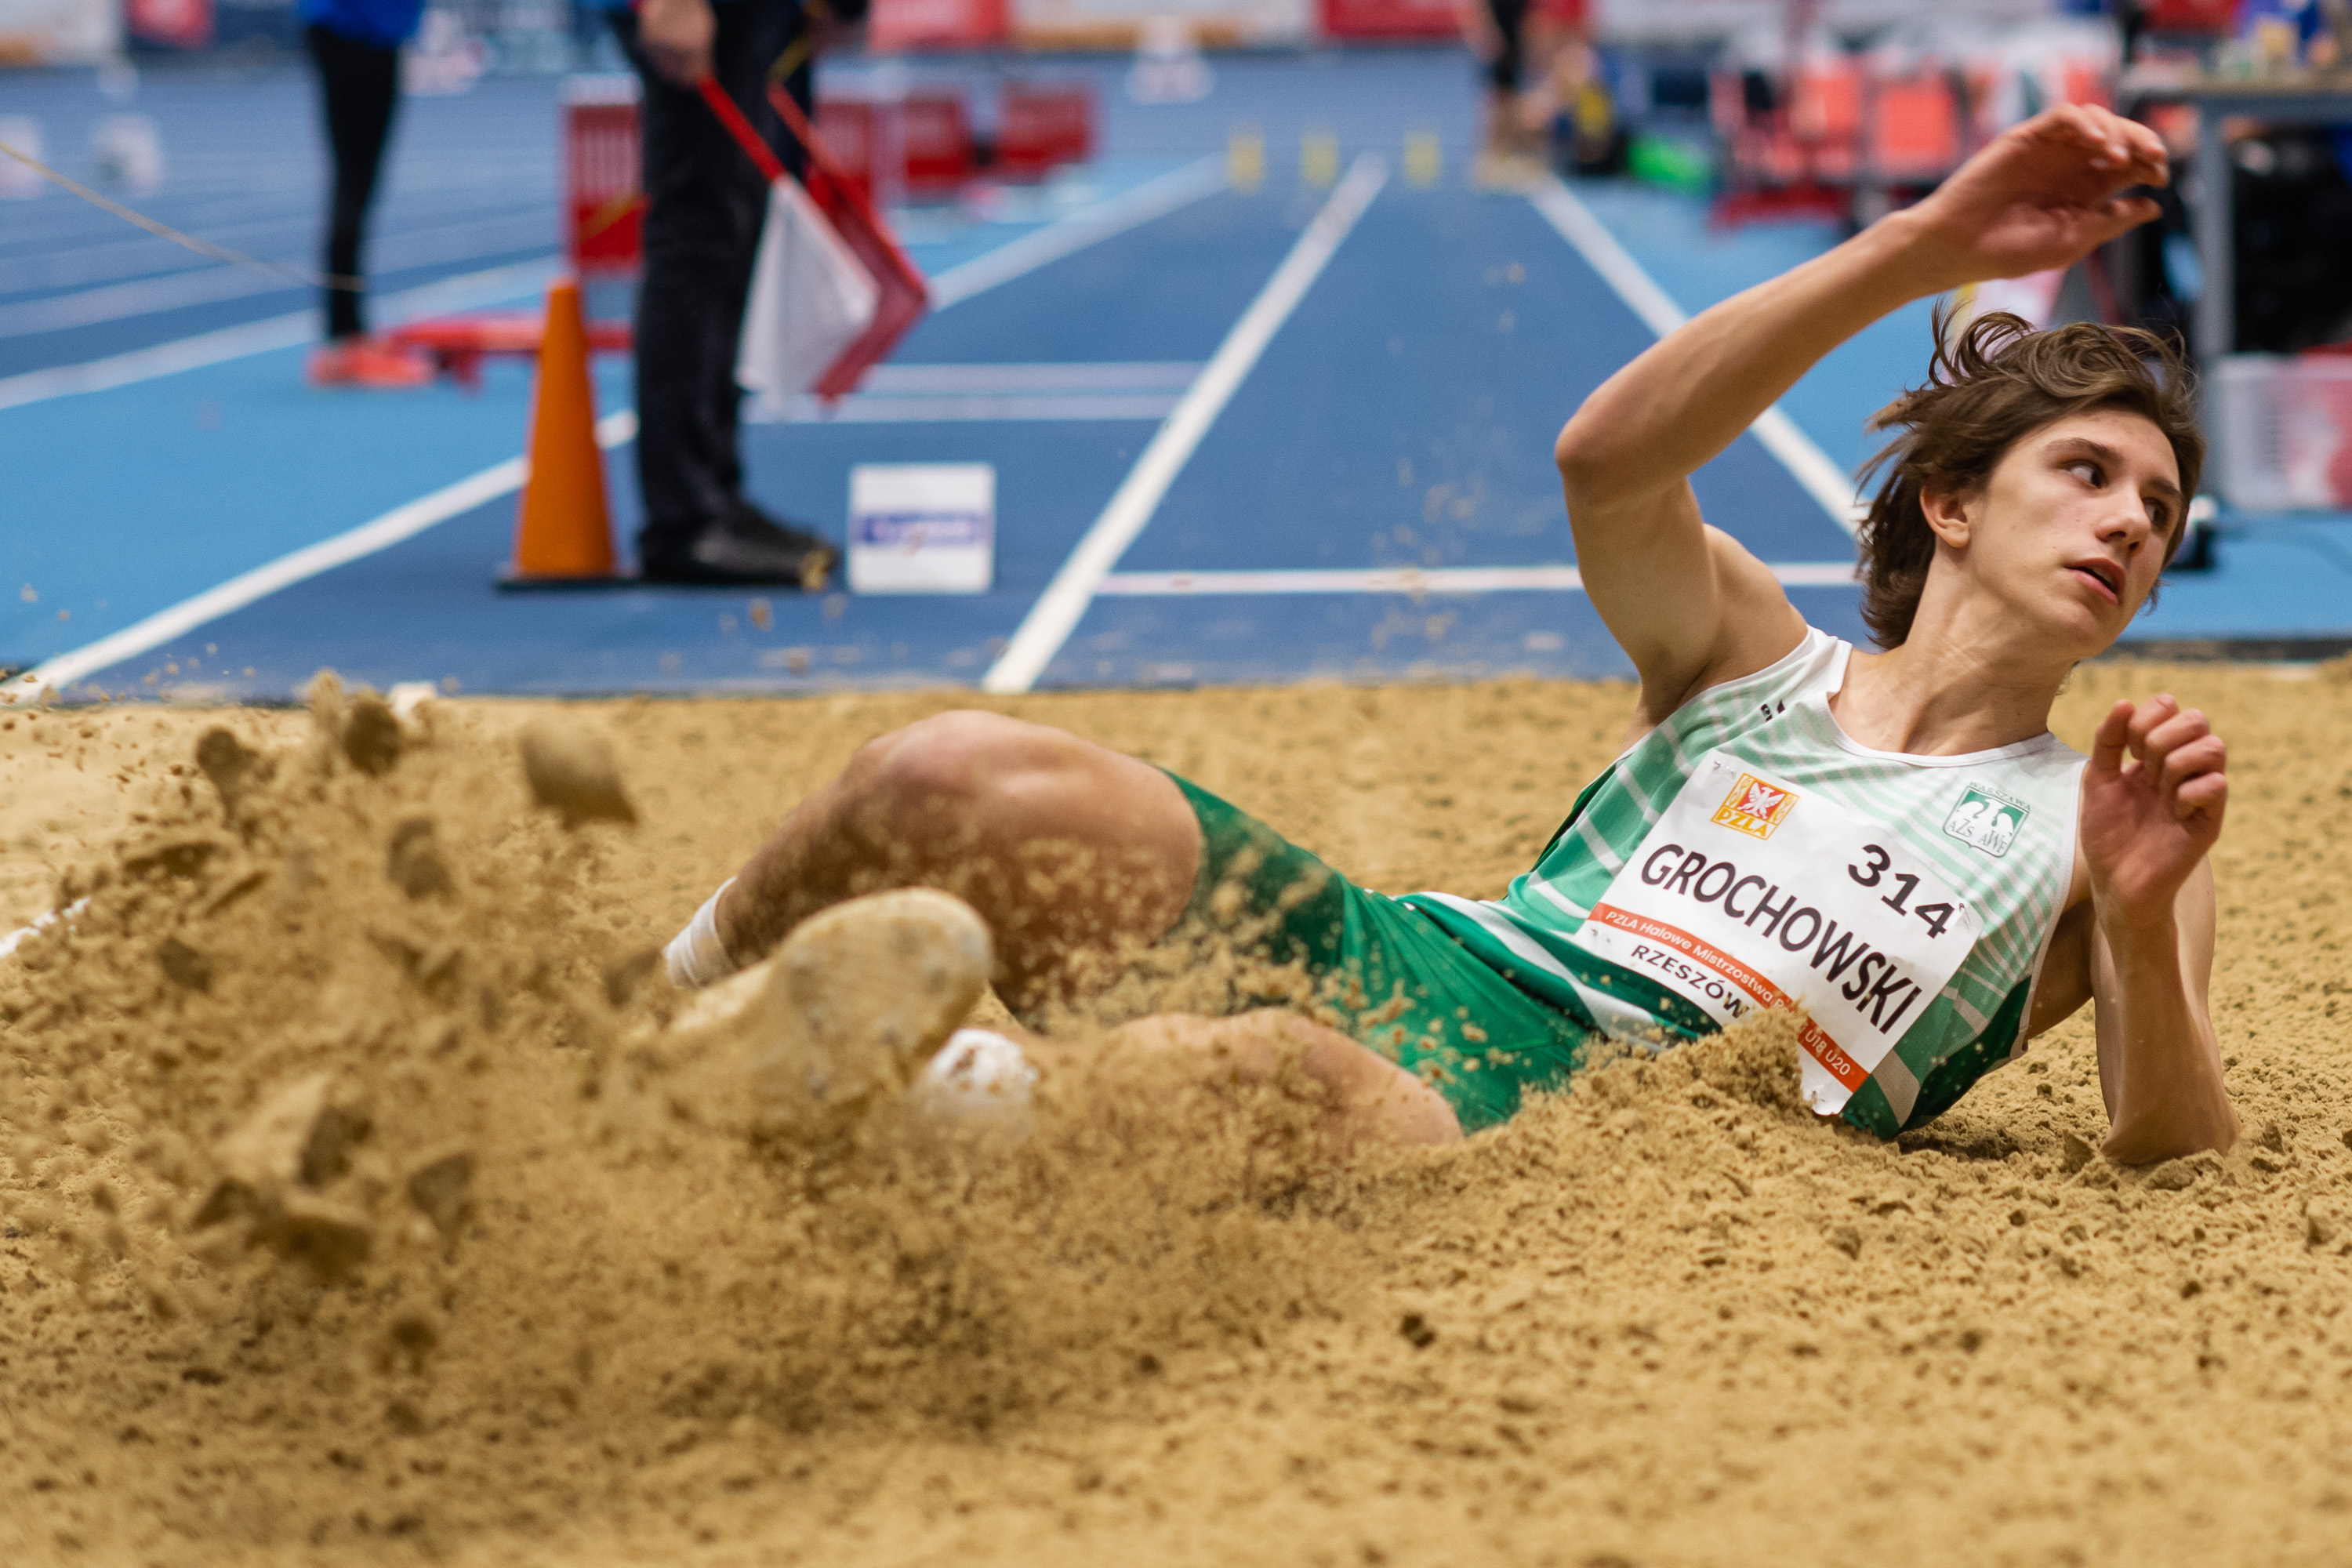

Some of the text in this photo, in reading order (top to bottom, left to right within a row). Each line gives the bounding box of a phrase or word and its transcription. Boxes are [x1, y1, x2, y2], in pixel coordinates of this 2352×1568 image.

[1715, 809, 1768, 837] PZLA
[1969, 782, 2031, 812] WARSZAWA
[1947, 818, 2008, 854] AZS AWF
[1847, 844, 1955, 939] 314
[1640, 843, 1923, 1035] GROCHOWSKI
[1606, 910, 1851, 1076] PZLA Halowe Mistrzostwa U18 U20
[1631, 944, 1751, 1019] RZESZÓW
